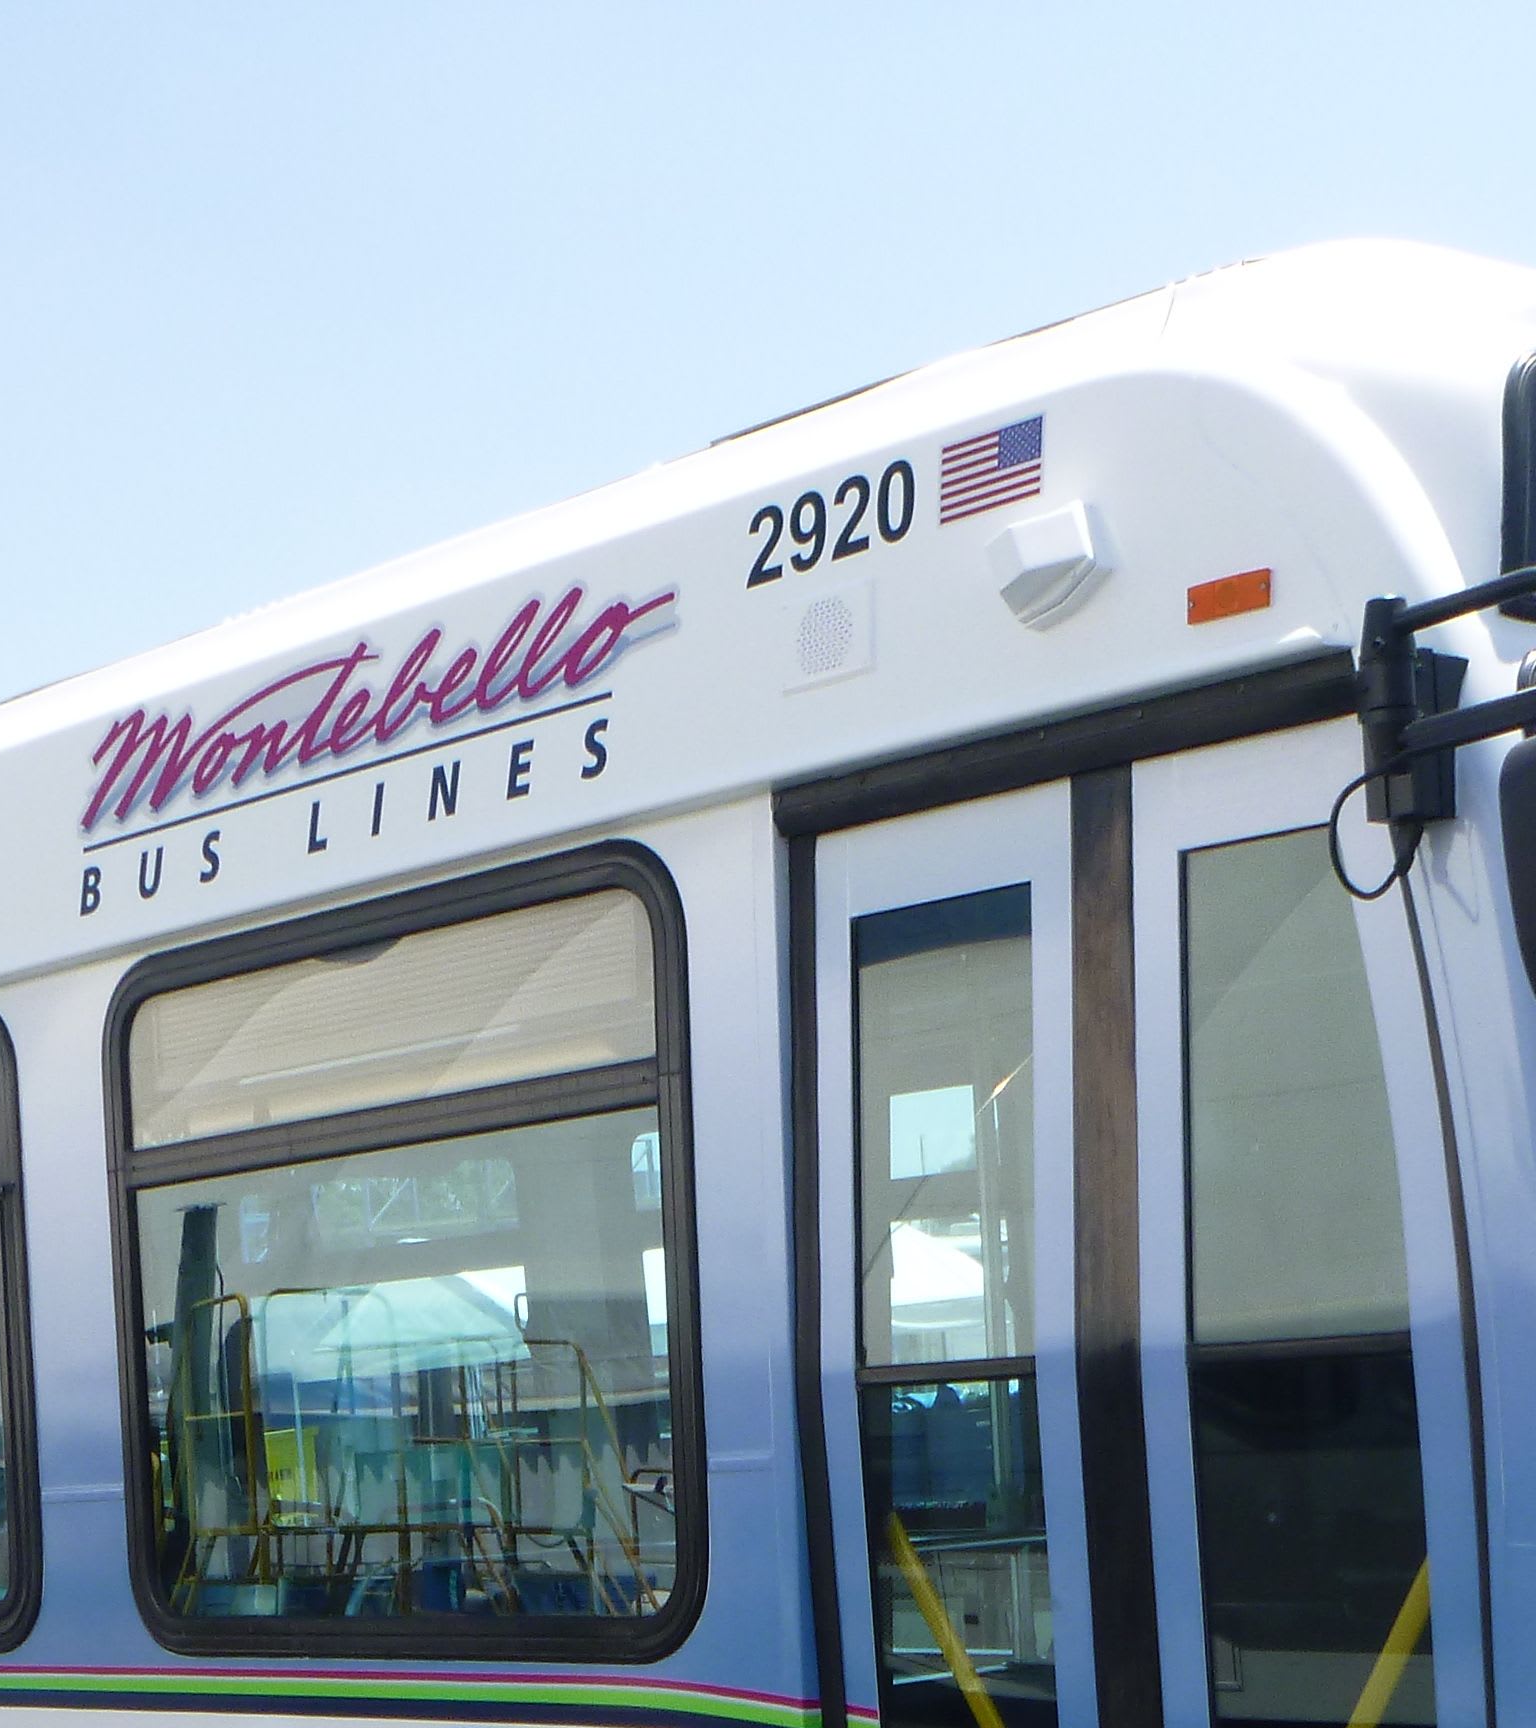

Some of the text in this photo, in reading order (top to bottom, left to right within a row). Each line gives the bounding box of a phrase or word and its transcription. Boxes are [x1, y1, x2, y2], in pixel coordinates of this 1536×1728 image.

[746, 460, 915, 589] 2920
[81, 586, 675, 831] Montebello
[79, 719, 610, 917] BUS LINES
